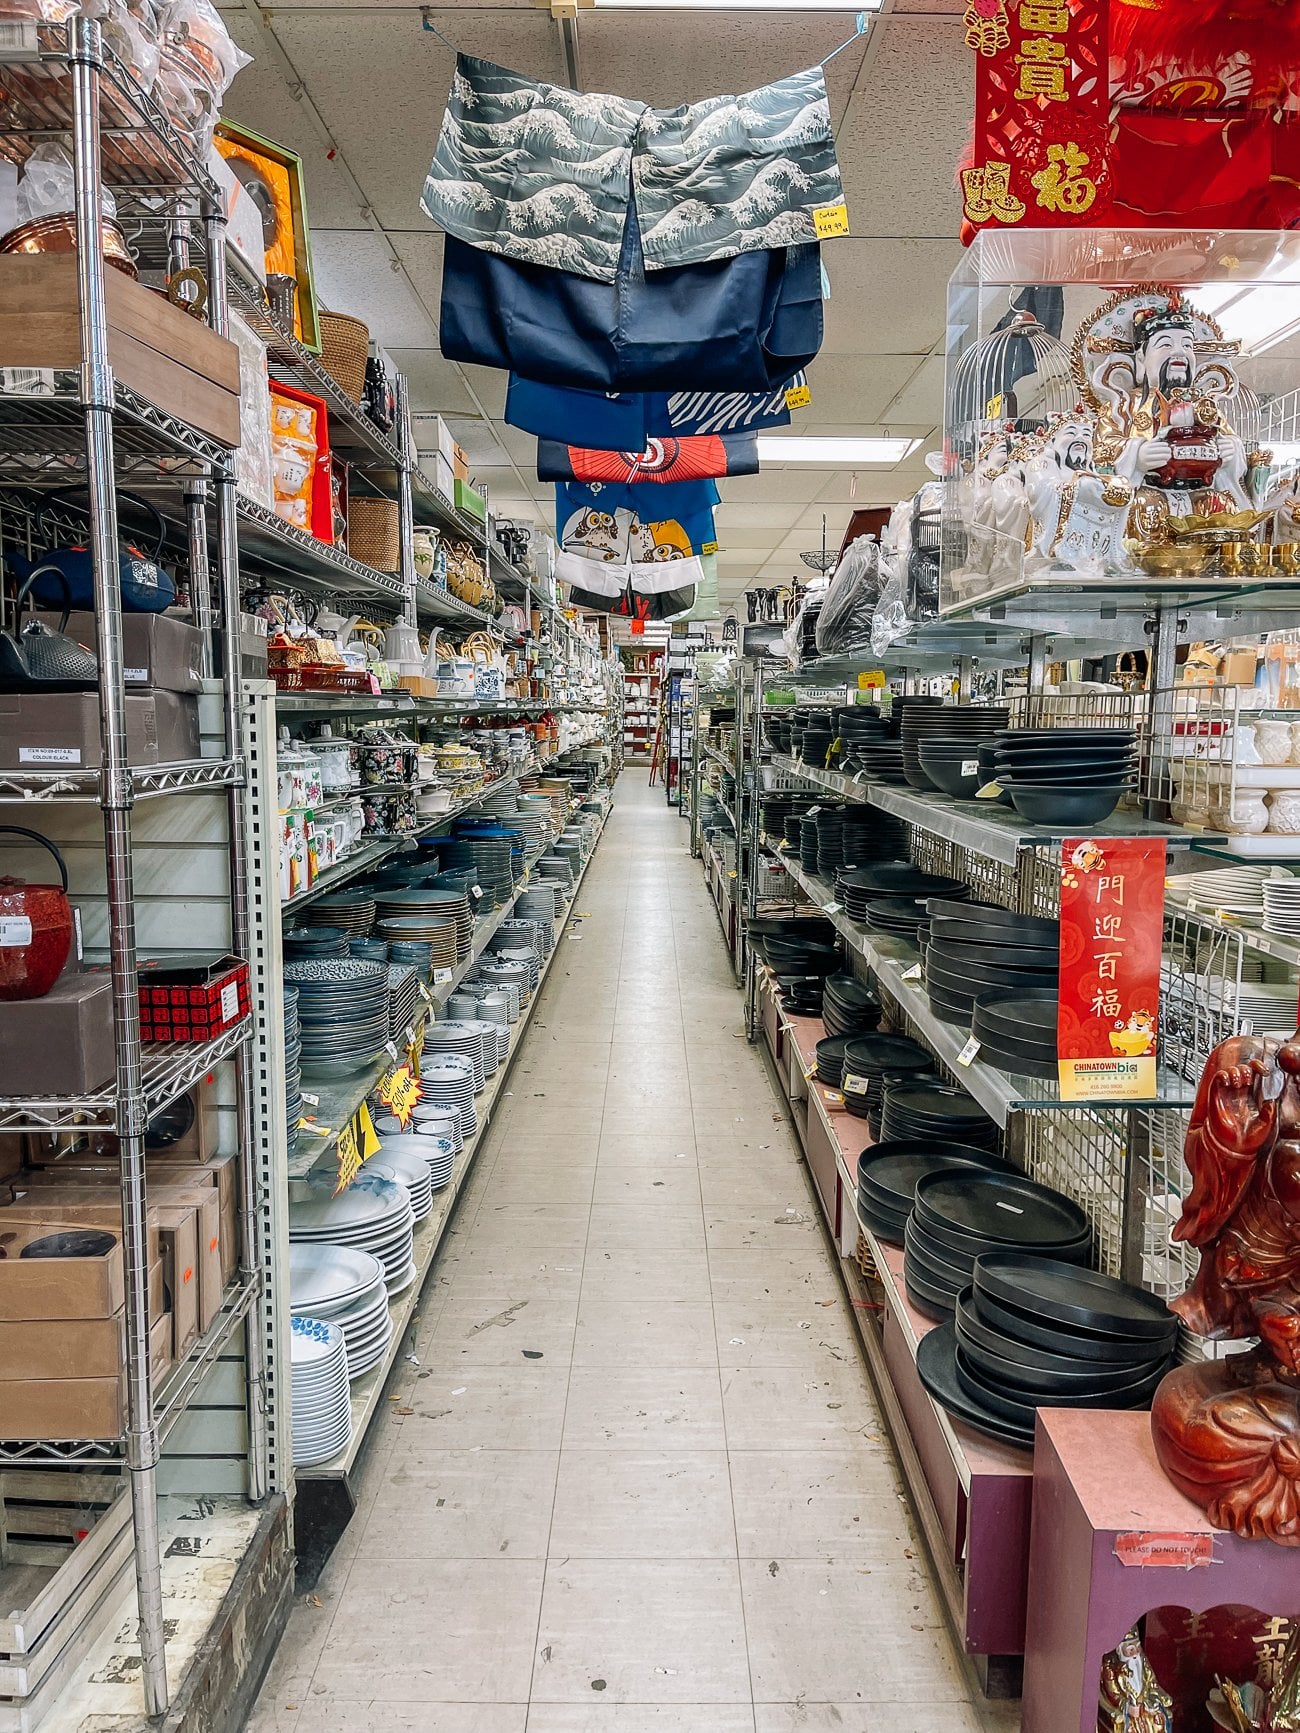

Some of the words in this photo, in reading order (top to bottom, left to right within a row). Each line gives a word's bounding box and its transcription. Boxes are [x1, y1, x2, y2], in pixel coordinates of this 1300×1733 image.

[1030, 141, 1097, 214] 福
[1090, 874, 1126, 1018] 門迎百福
[1074, 1062, 1117, 1071] CHINATOWN
